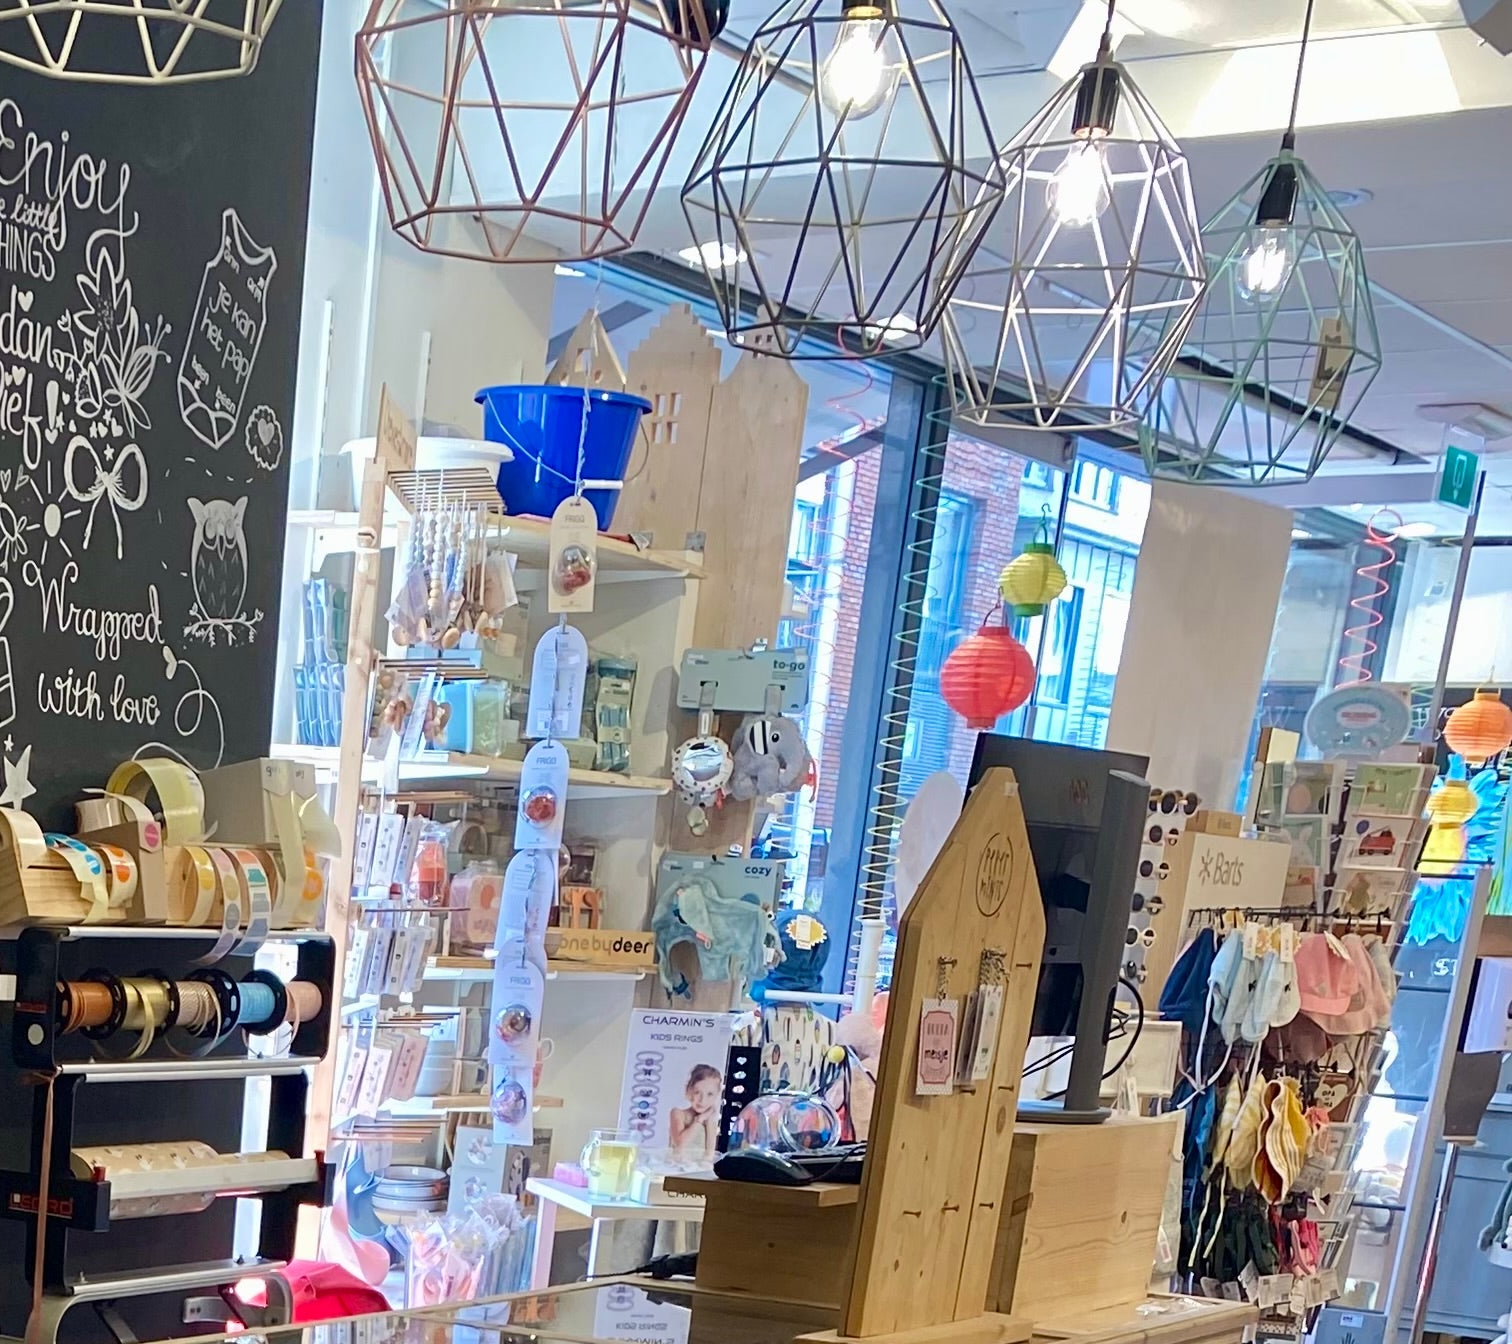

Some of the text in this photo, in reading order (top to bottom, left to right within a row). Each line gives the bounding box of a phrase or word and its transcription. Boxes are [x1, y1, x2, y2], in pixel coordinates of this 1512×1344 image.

[10, 193, 59, 233] little
[200, 306, 224, 352] het
[208, 280, 257, 345] Je kan
[22, 560, 165, 662] Wrapped
[38, 668, 161, 726] with love
[744, 865, 773, 877] cozy
[1212, 851, 1245, 887] Barts
[613, 936, 654, 954] deer
[642, 1015, 716, 1029] CHARMIN'S
